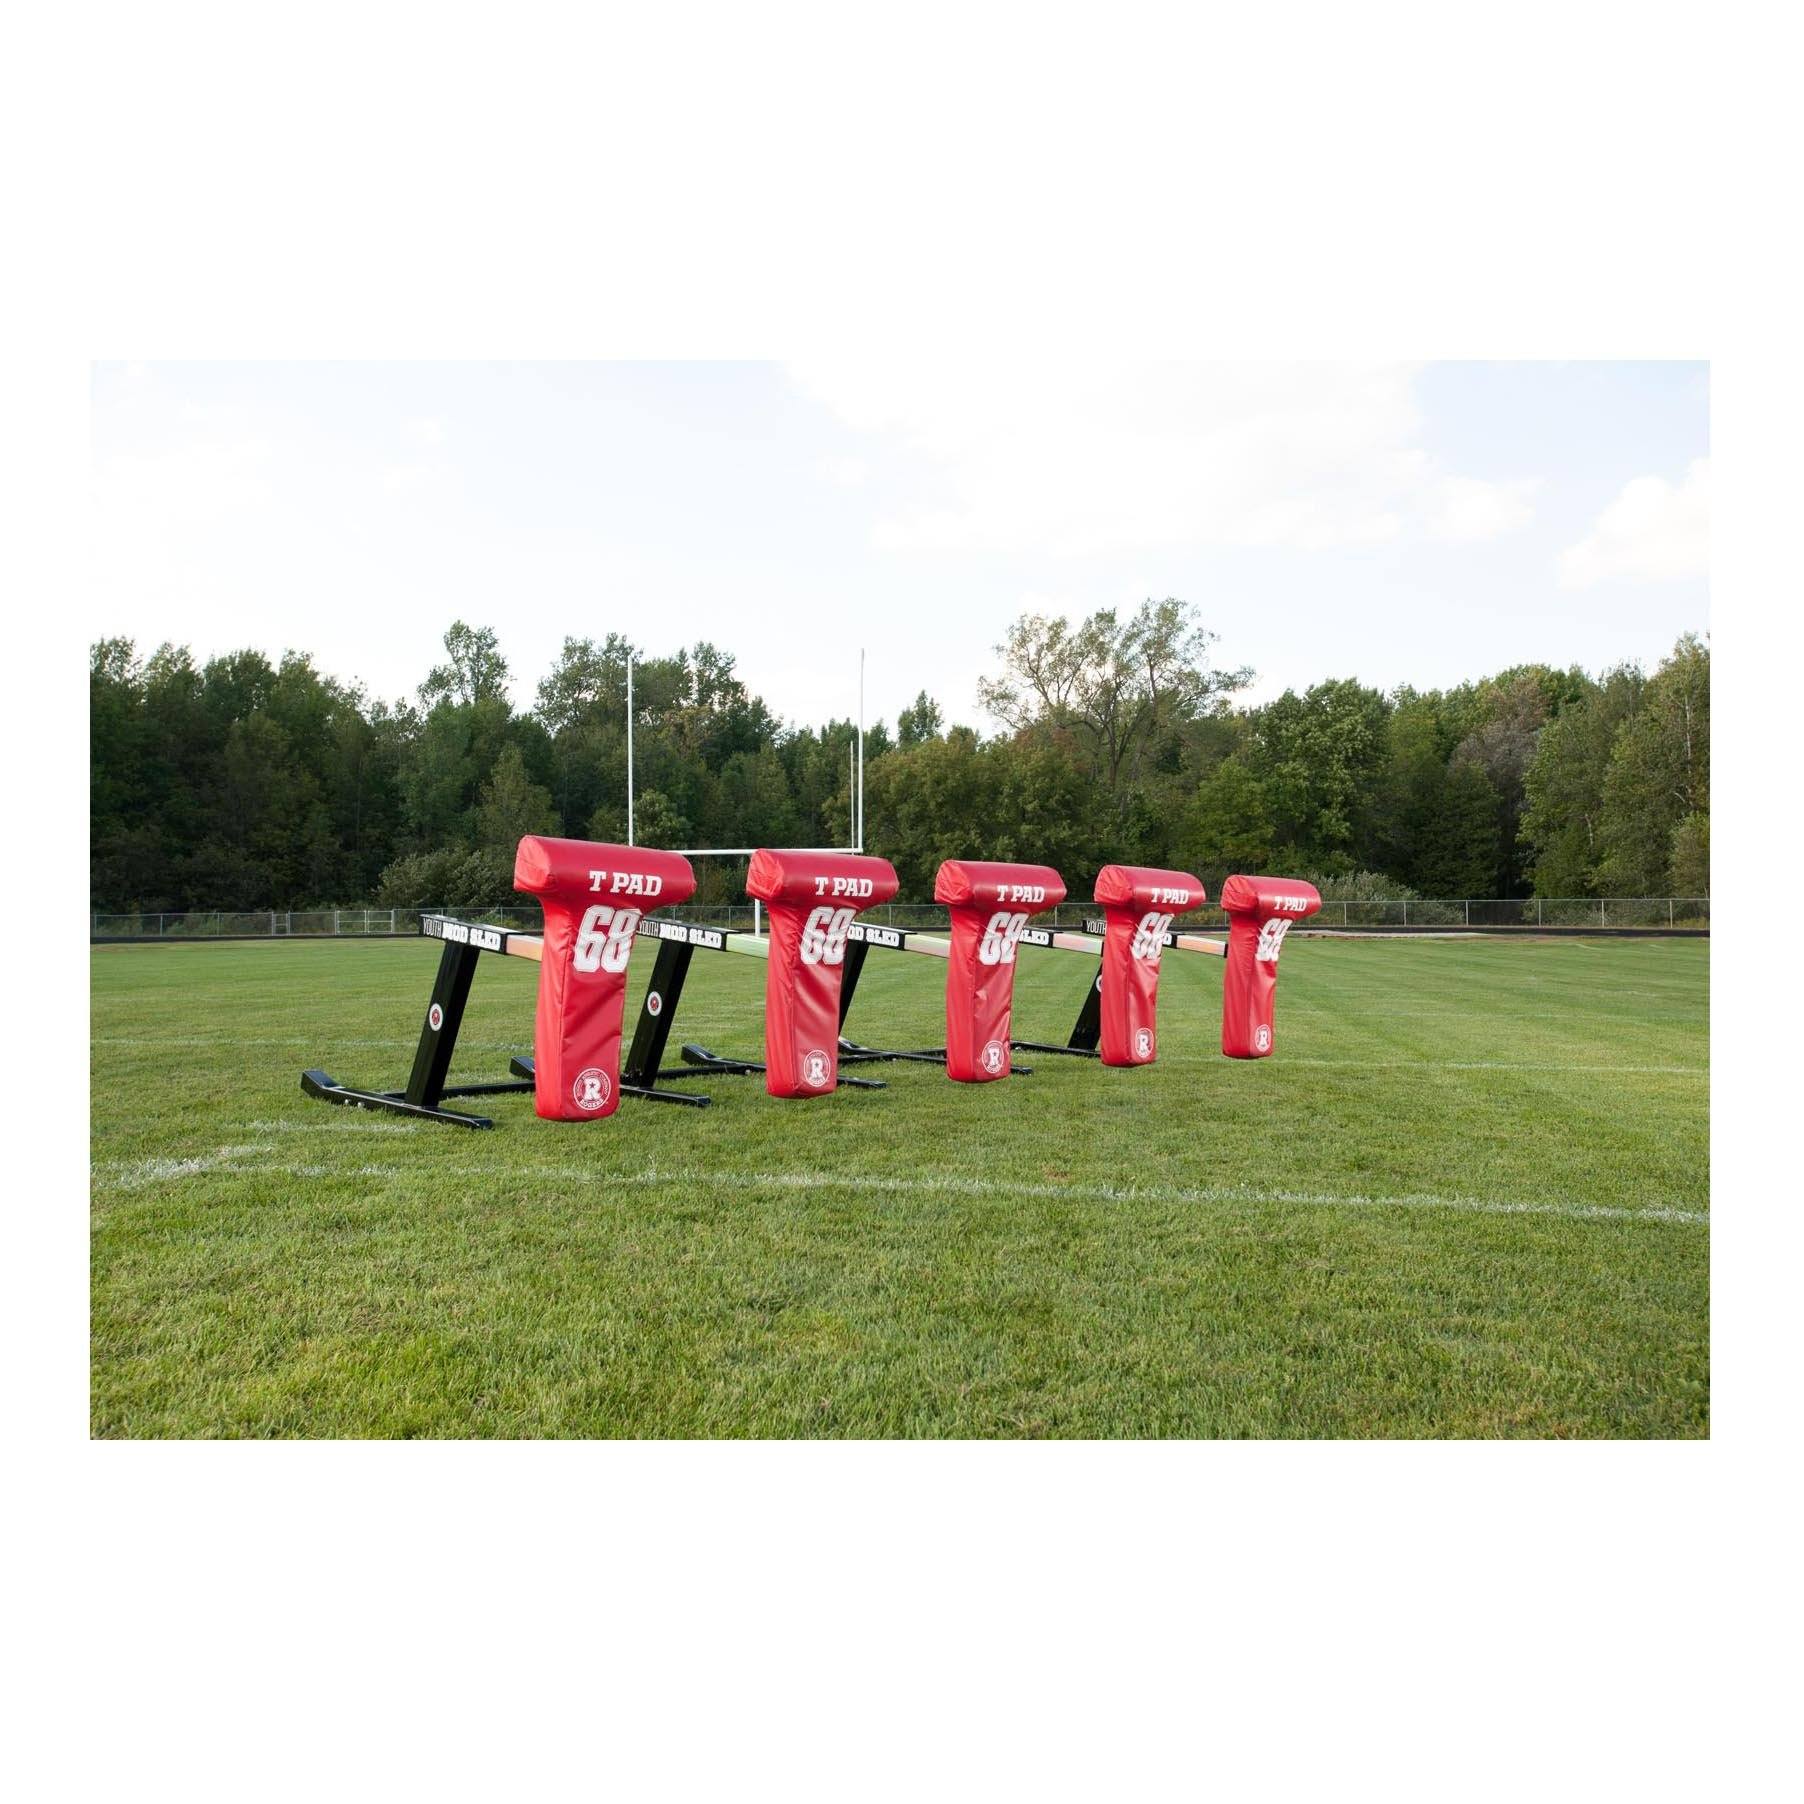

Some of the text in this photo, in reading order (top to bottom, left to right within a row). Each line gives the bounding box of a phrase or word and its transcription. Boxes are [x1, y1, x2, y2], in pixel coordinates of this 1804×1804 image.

[589, 870, 663, 896] T PAD
[815, 877, 873, 897] T PAD
[997, 885, 1045, 903] T PAD
[1151, 888, 1189, 905] T PAD
[1274, 896, 1307, 911] T PAD
[423, 918, 501, 951] YOUTH MOD SLED
[573, 904, 641, 973] 68
[659, 923, 688, 942] MOD
[689, 928, 722, 949] SLED
[800, 907, 857, 965] 68
[847, 925, 900, 947] OD SLED
[979, 911, 1030, 966] 68
[1132, 912, 1175, 960] 68
[1255, 917, 1293, 961] 68
[583, 1077, 602, 1101] R
